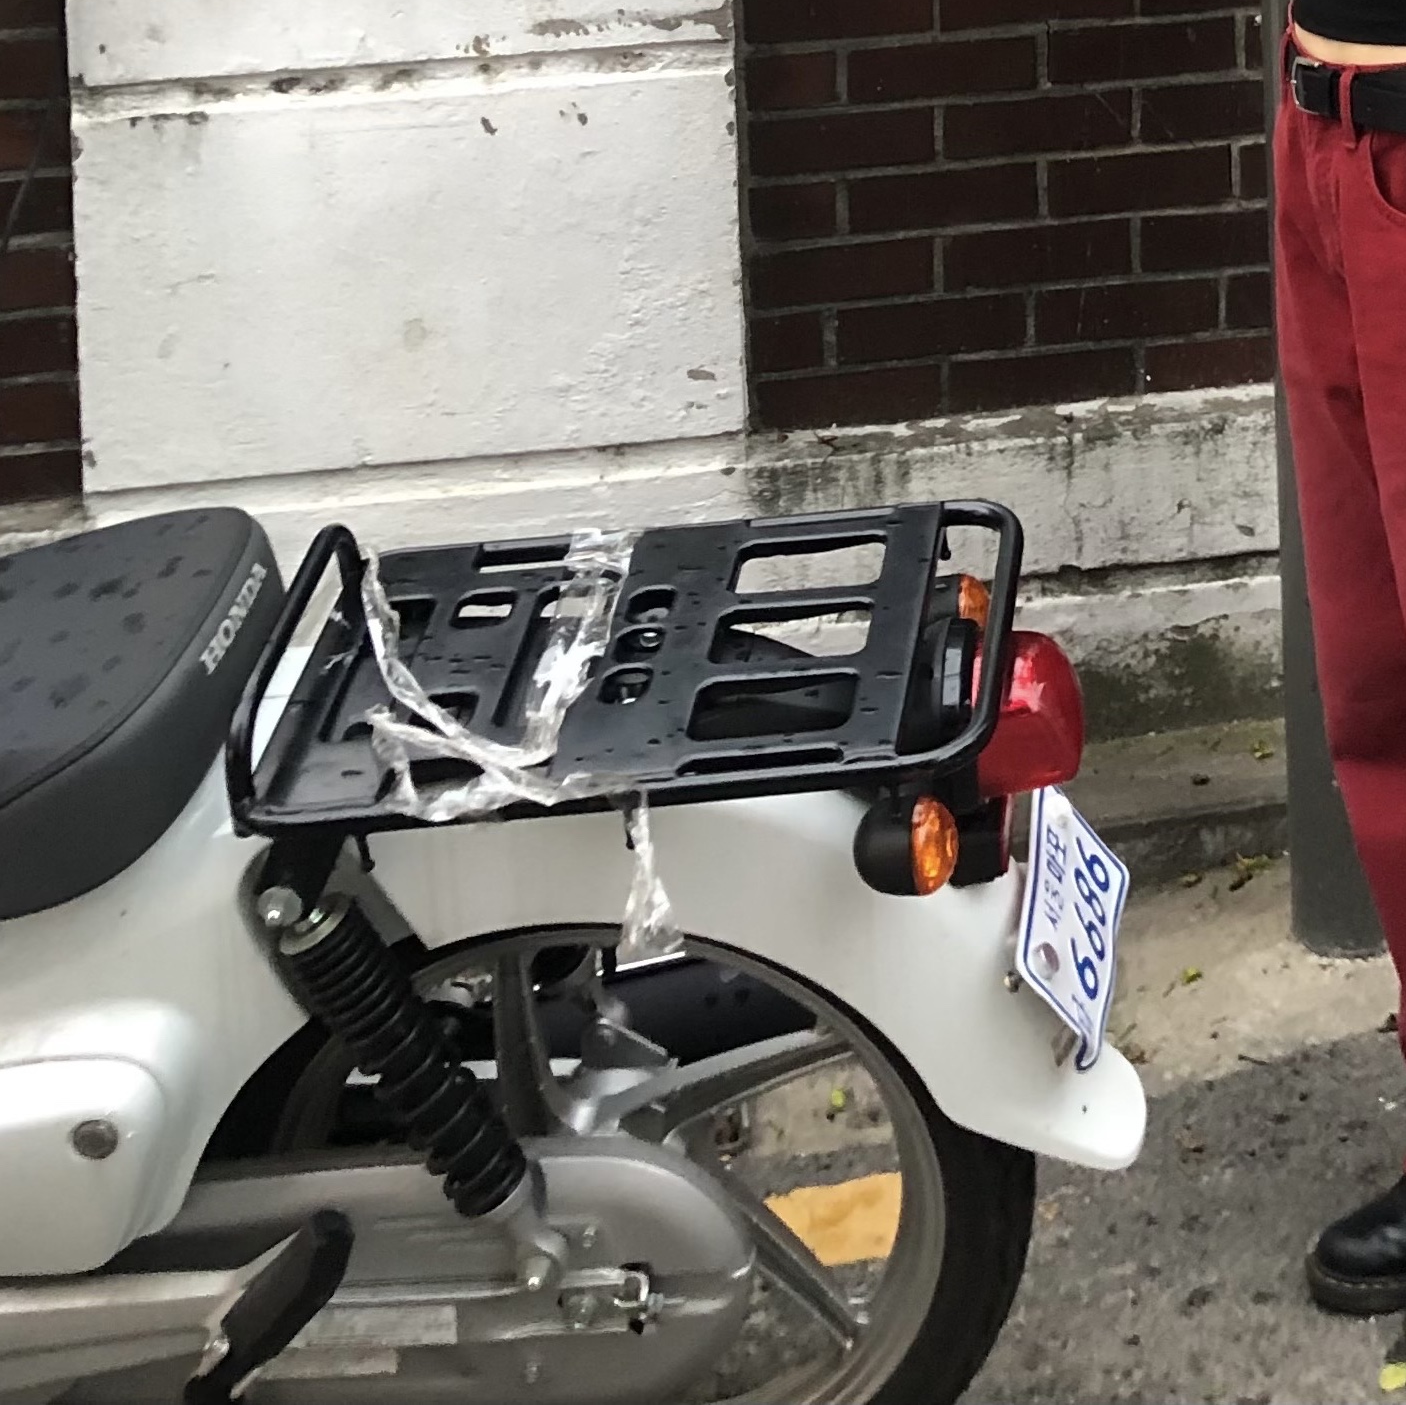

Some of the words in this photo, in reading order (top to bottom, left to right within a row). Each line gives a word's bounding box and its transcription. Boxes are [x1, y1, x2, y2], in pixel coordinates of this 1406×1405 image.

[199, 562, 268, 676] HONDA
[1046, 823, 1067, 884] 마포
[1043, 880, 1065, 931] 서울
[1070, 836, 1111, 1001] 6686
